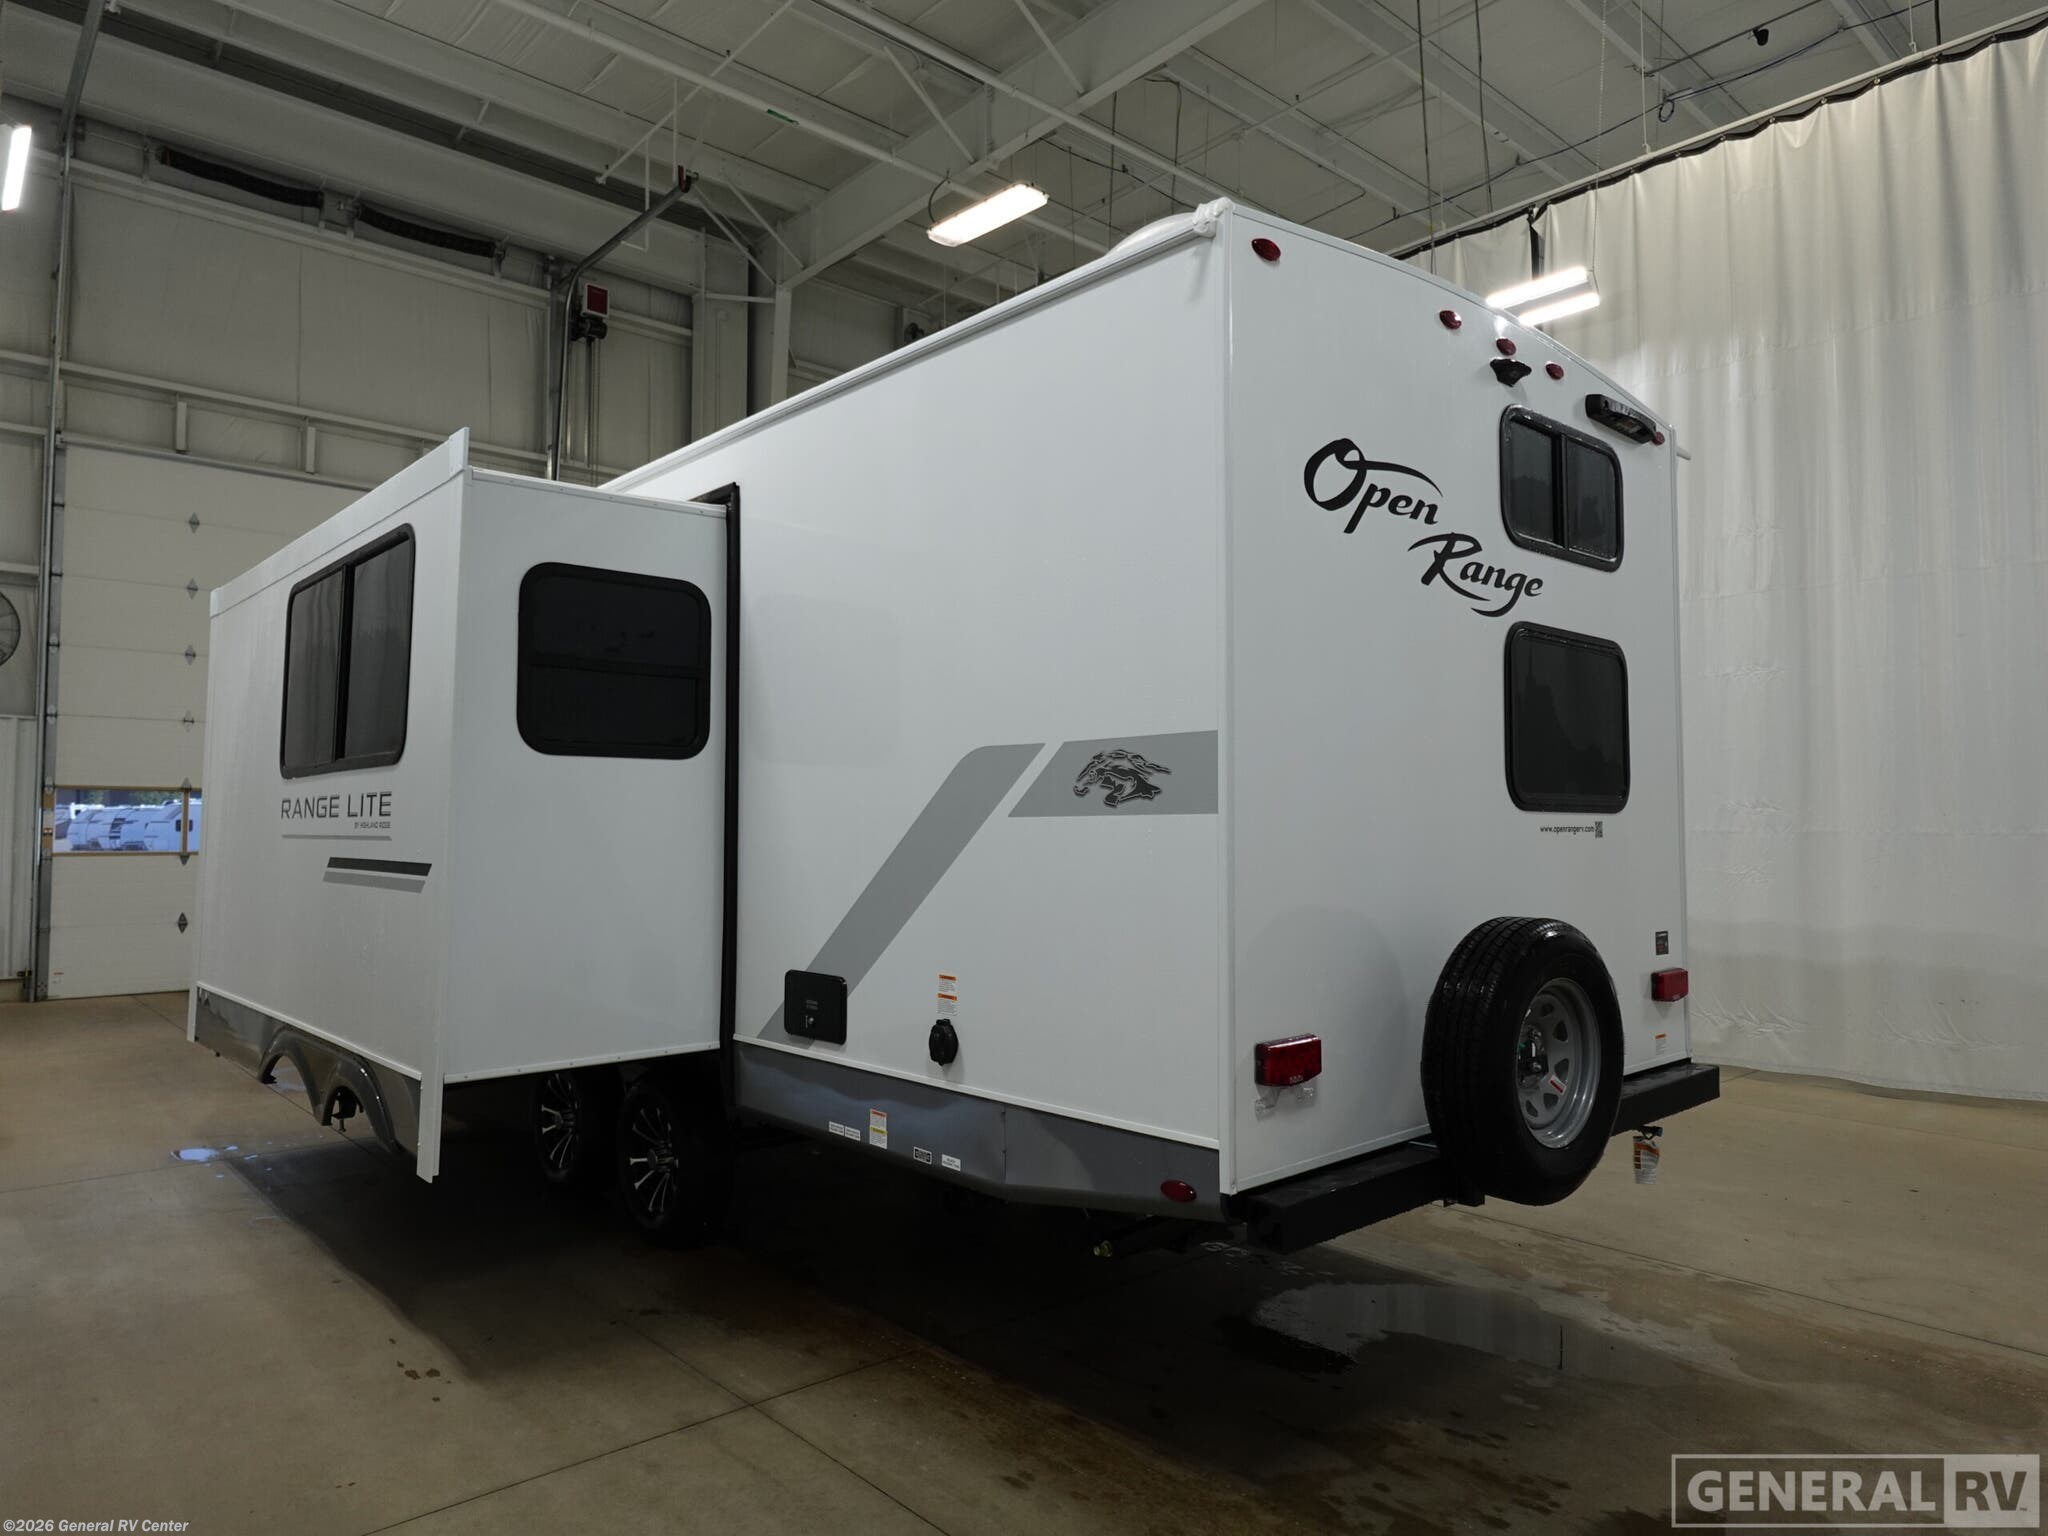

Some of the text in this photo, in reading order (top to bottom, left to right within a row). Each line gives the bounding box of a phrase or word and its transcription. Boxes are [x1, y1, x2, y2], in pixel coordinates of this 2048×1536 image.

[1304, 438, 1443, 534] Open
[1407, 532, 1543, 617] Range
[281, 791, 392, 819] RANGE LITE
